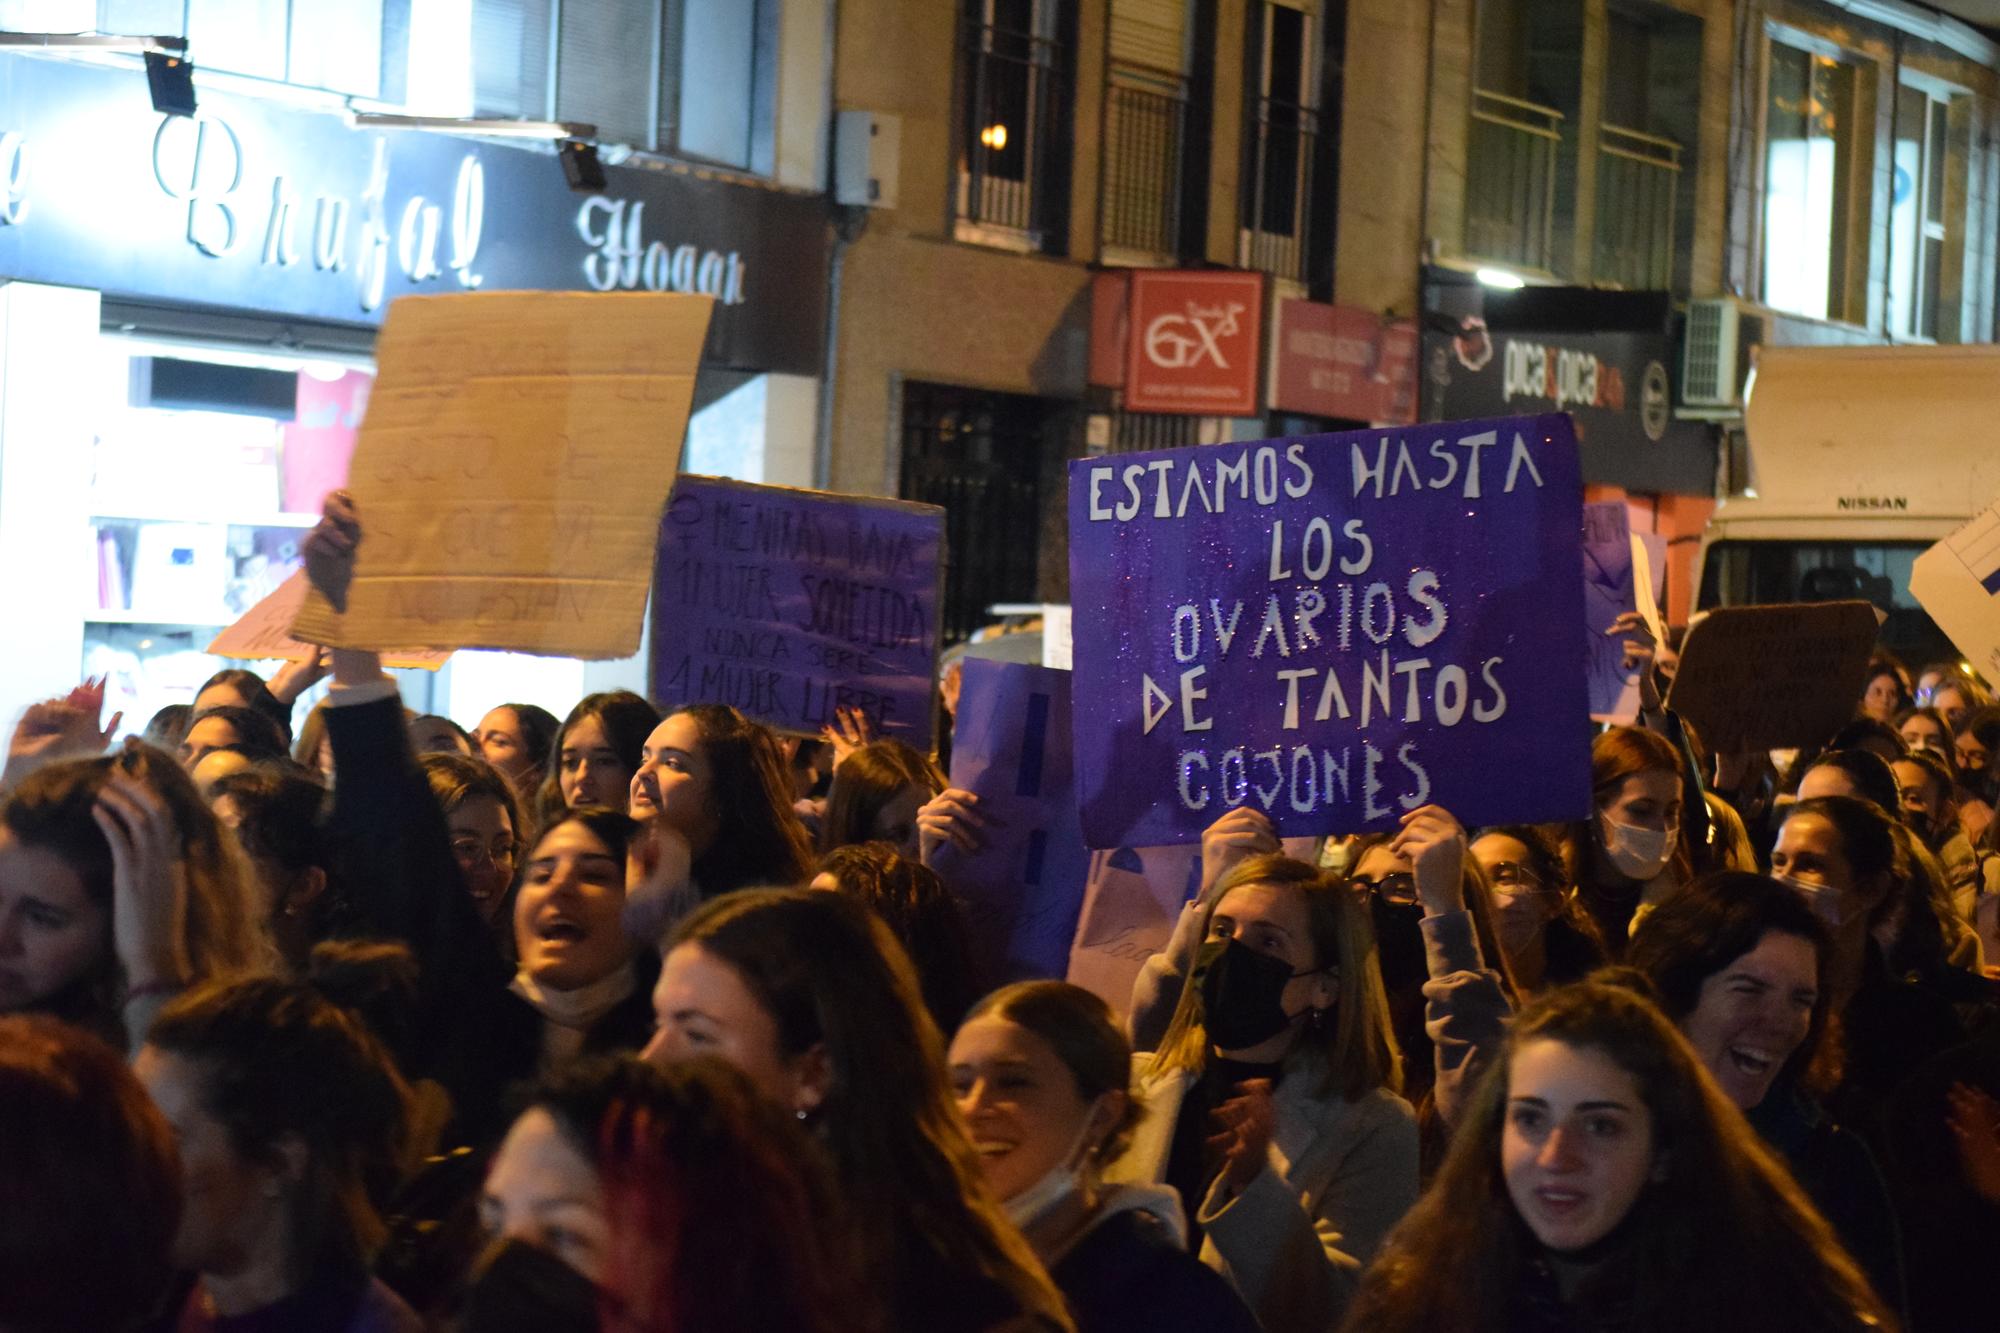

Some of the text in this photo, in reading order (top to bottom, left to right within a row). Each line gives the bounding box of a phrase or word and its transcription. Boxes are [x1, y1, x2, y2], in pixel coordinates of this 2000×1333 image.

[1089, 430, 1543, 521] ESTAMOS HASTA
[1837, 496, 1907, 511] NISSAN
[1269, 517, 1372, 581] LOS
[704, 627, 790, 659] NUNCA
[1171, 569, 1448, 663] OVARIOS
[700, 662, 789, 718] MUJER
[1142, 649, 1507, 736] DE TANTOS
[1177, 743, 1431, 822] COJONES
